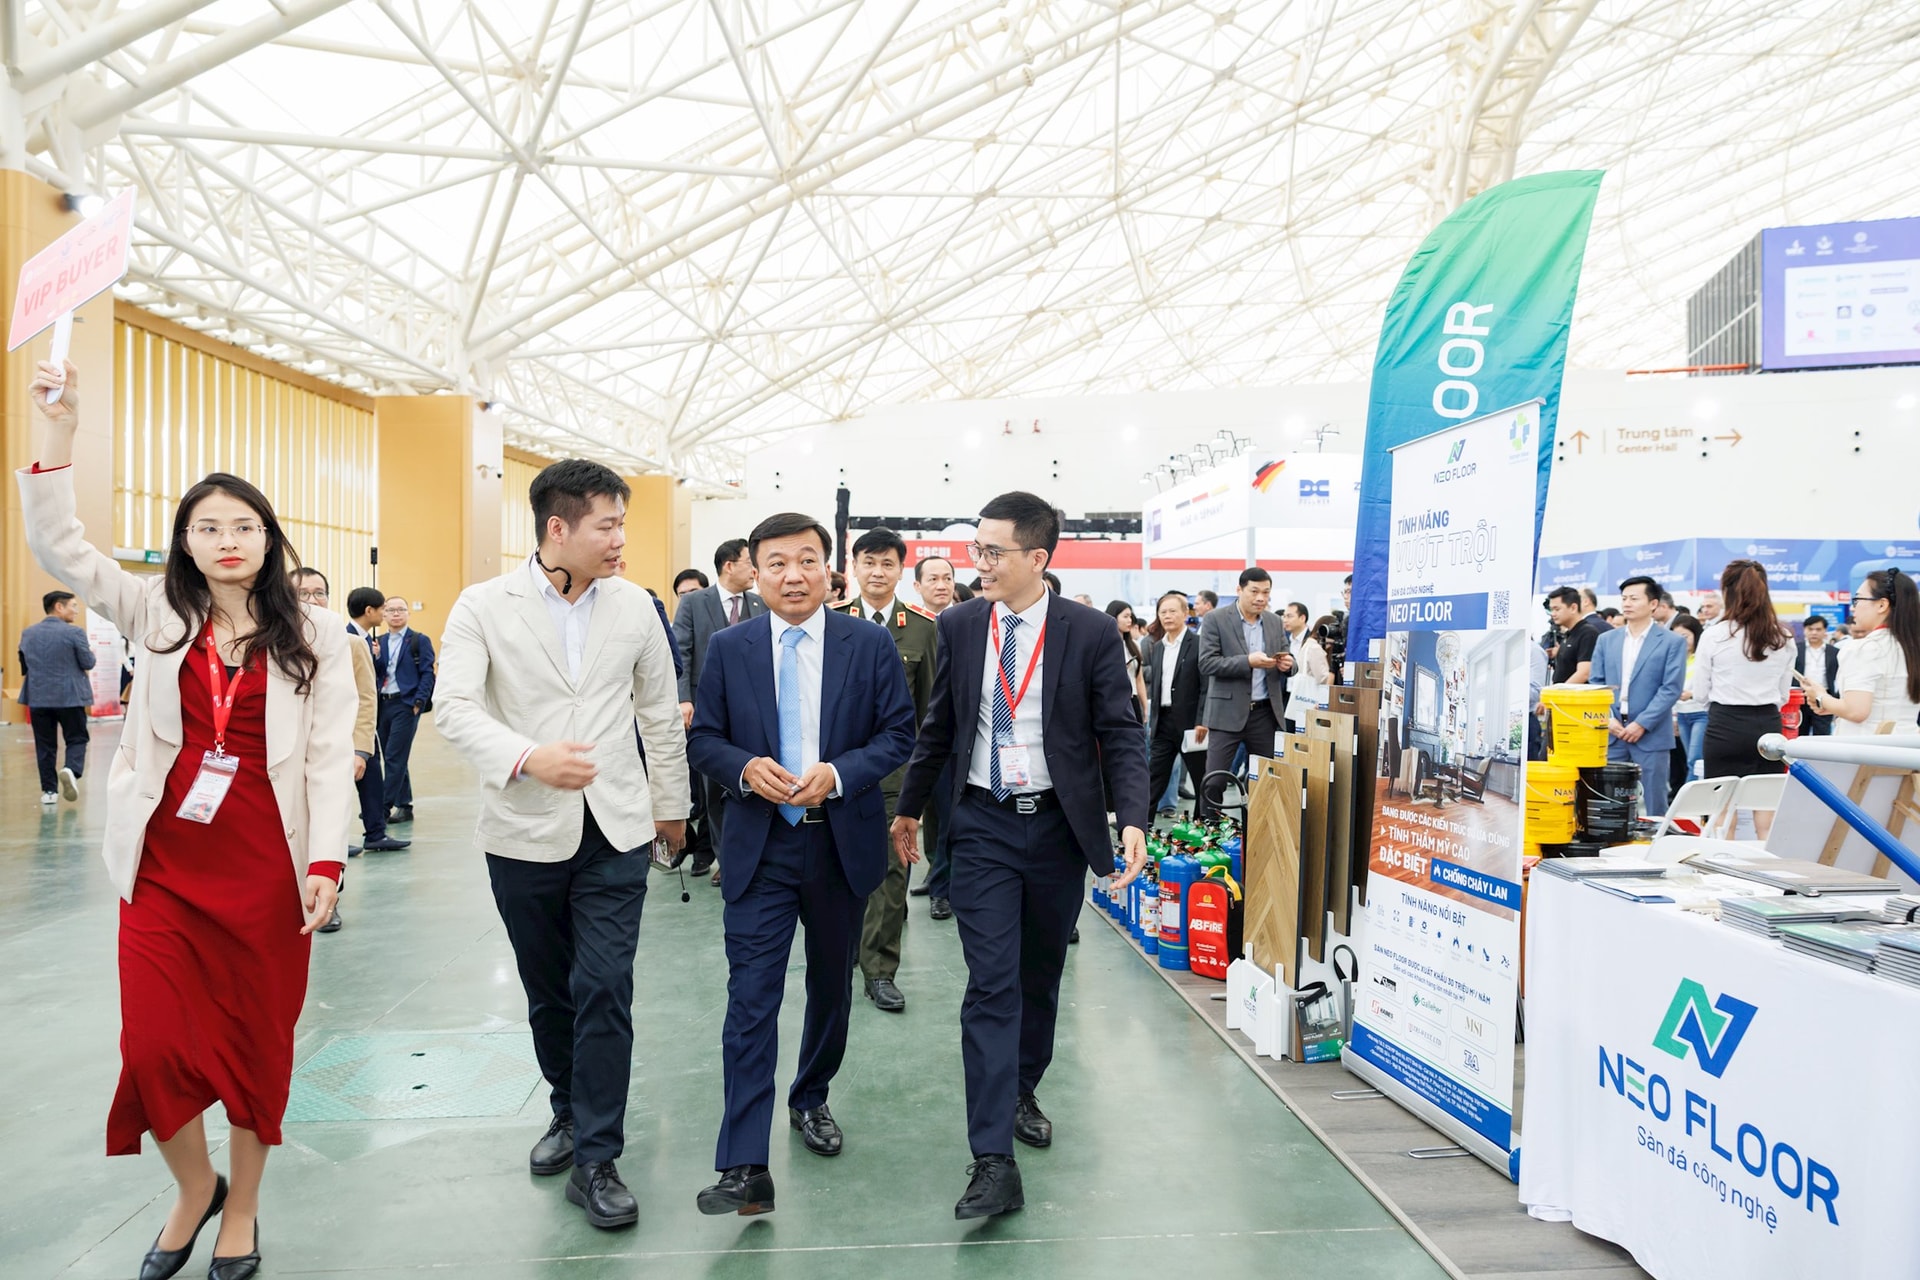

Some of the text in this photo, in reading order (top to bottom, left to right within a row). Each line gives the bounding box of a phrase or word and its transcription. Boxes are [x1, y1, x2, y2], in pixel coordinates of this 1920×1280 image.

[24, 235, 119, 317] VIP BUYER
[1432, 301, 1494, 419] OOR
[1616, 427, 1660, 442] Trung
[1616, 442, 1678, 454] Center Hall
[1433, 462, 1477, 484] NEO FLOOR
[1398, 508, 1449, 536] TÍNH NĂNG
[1396, 519, 1497, 579] VƯỢT TRỘI
[1389, 601, 1453, 623] NEO FLOOR
[1584, 711, 1608, 720] NAN
[1382, 805, 1399, 818] ĐANG
[1399, 809, 1418, 825] ĐƯỢC
[1418, 813, 1432, 827] CÁC
[1432, 816, 1449, 831] KIẾN
[1449, 821, 1466, 836] TRÚC
[1388, 824, 1470, 861] TÍNH THẨM MỸ CAO
[1379, 844, 1428, 877] ĐẶC BIỆT
[1442, 867, 1508, 901] CHỐNG CHÁY LAN
[1401, 892, 1417, 908] TÍNH
[1417, 899, 1438, 916] NĂNG
[1452, 911, 1467, 928] BẬT
[1465, 1015, 1482, 1037] MSI
[1599, 1045, 1839, 1226] NEO FLOOR
[1637, 1125, 1777, 1234] Sàn đá công nghệ
